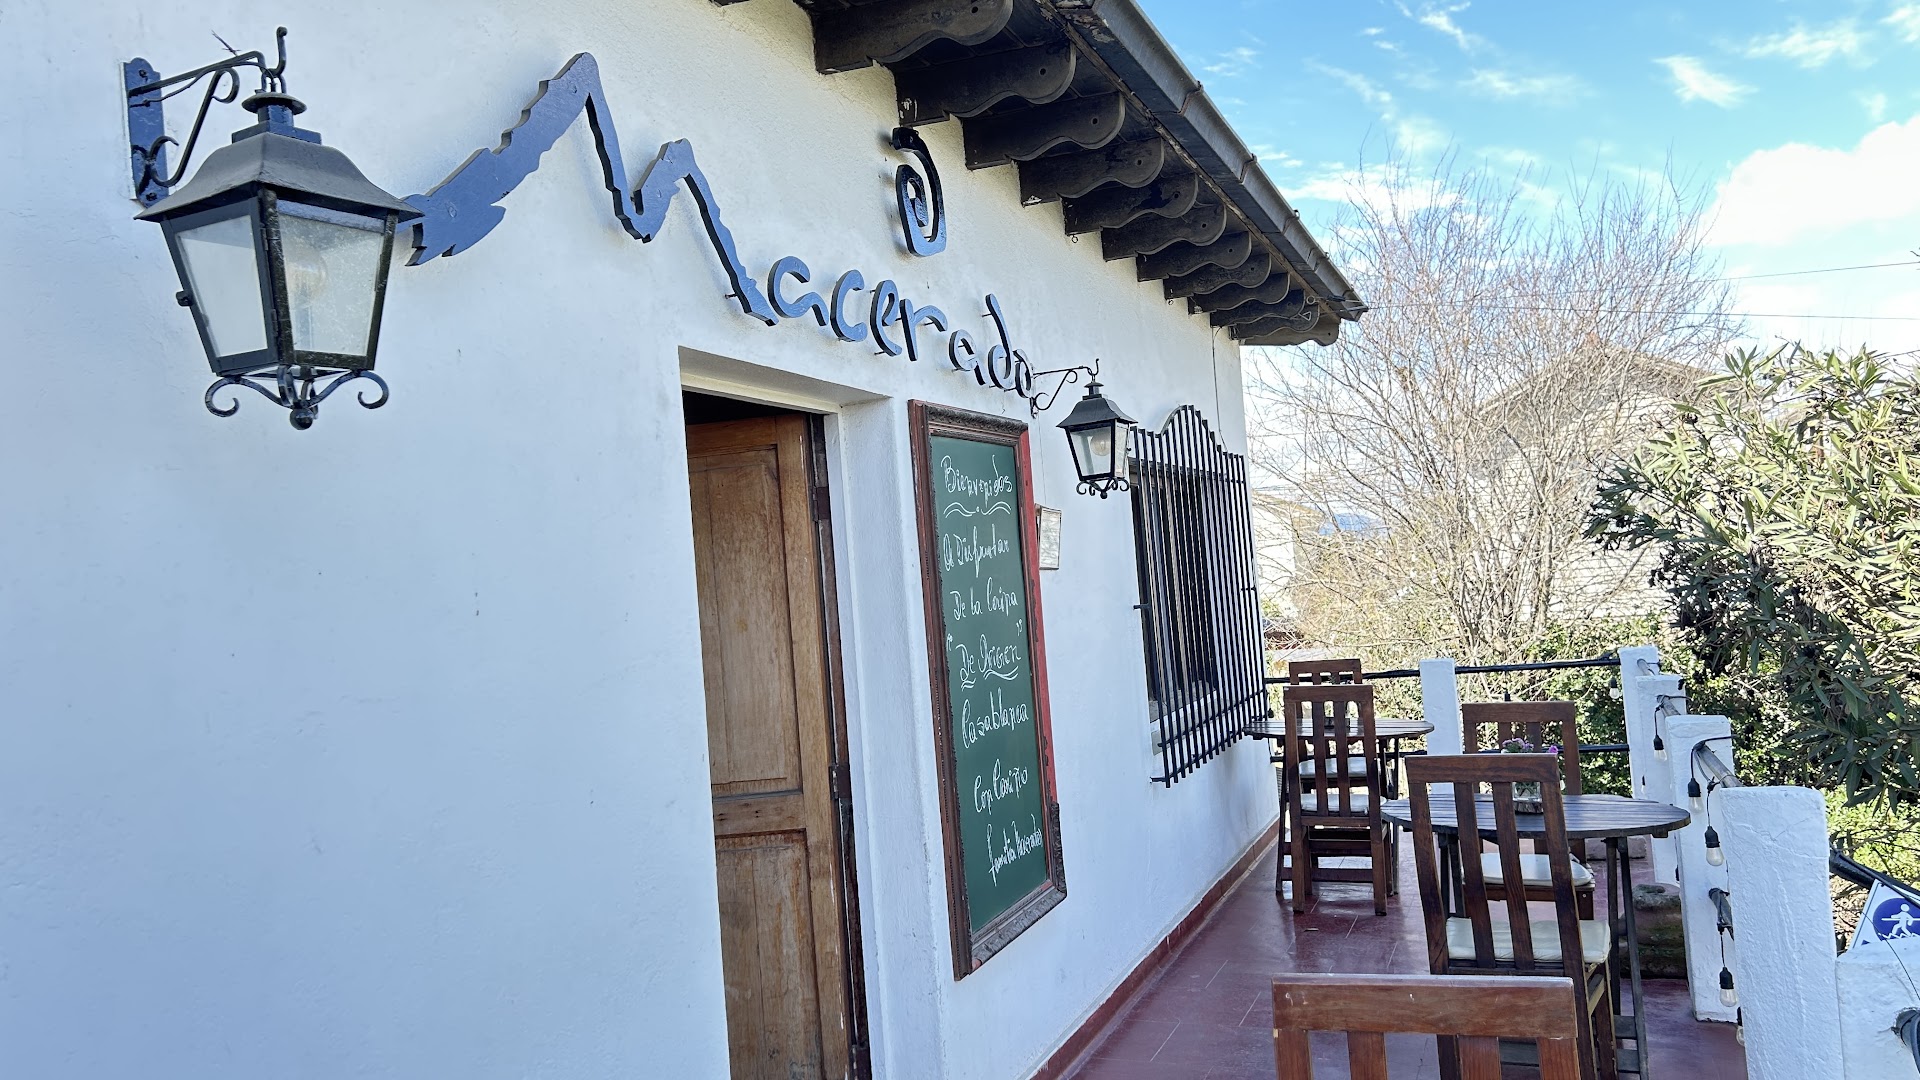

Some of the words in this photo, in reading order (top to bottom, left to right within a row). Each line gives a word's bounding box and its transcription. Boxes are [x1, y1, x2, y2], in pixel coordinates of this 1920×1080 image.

[395, 52, 1033, 399] Macerado
[941, 455, 1012, 507] Bienvenidos
[950, 591, 966, 620] De
[970, 587, 982, 615] la
[962, 687, 1029, 749] Casablanca
[974, 775, 993, 815] Con
[993, 759, 1028, 799] Cariño
